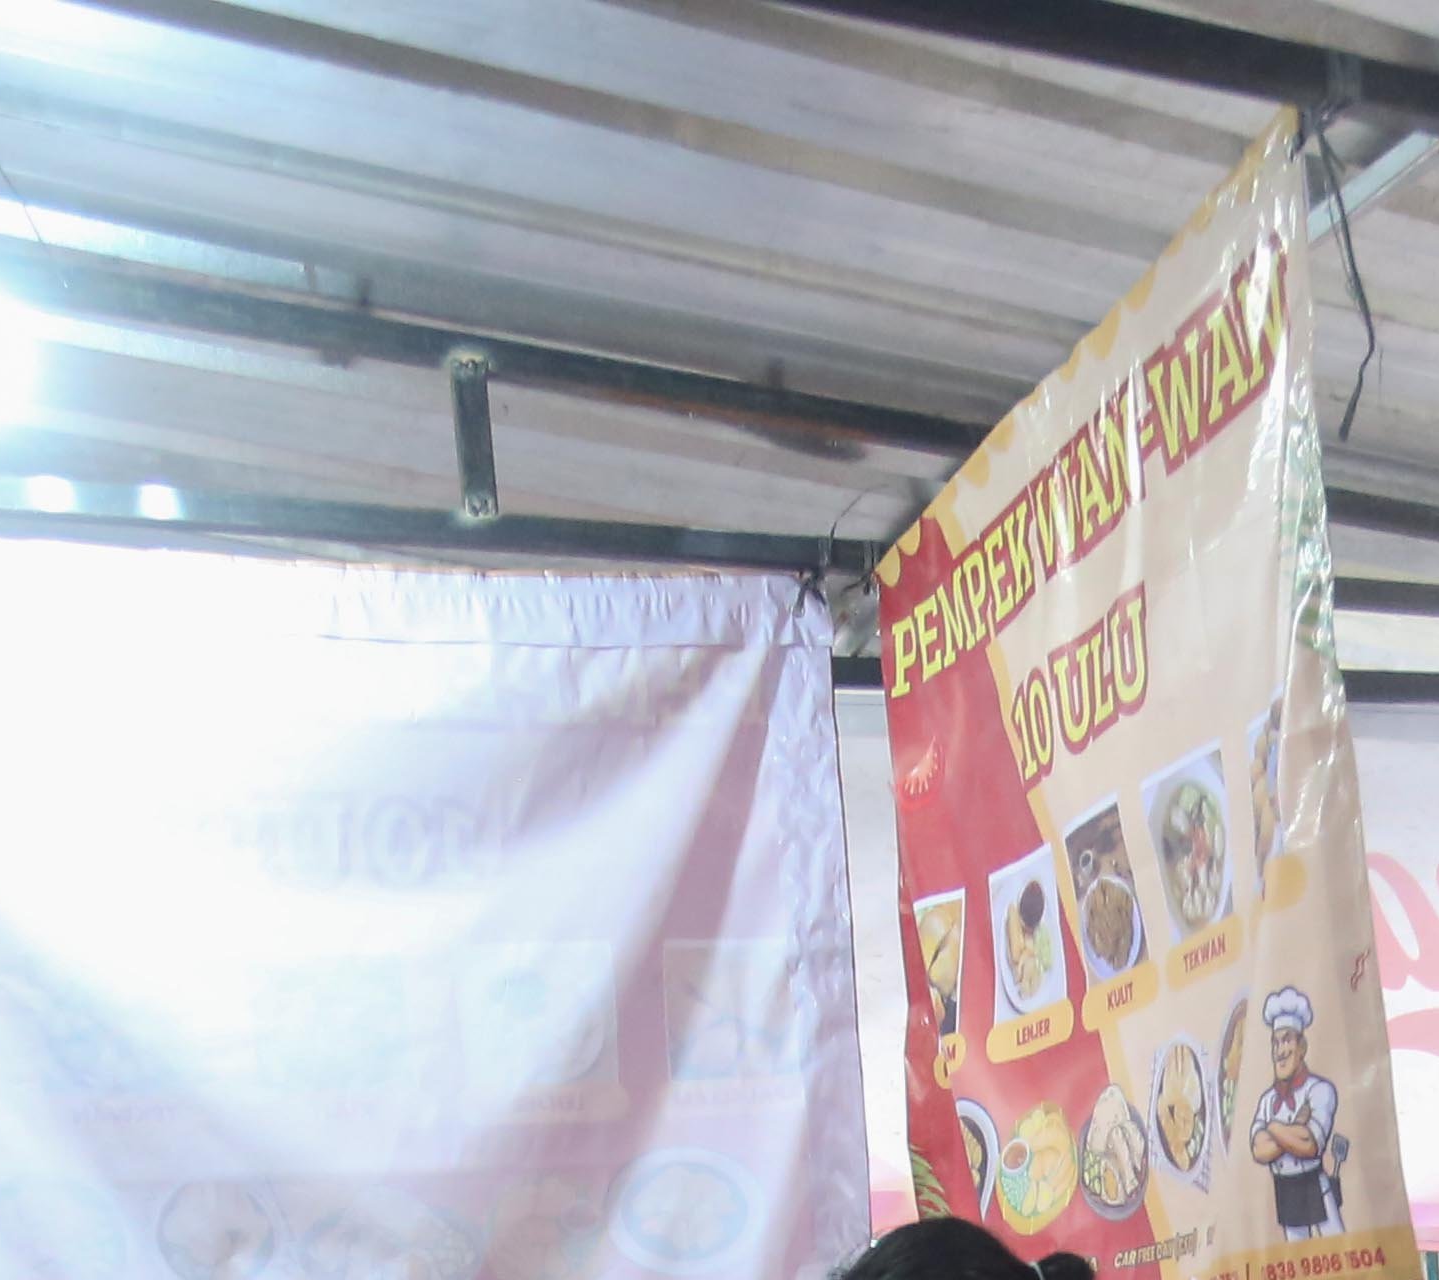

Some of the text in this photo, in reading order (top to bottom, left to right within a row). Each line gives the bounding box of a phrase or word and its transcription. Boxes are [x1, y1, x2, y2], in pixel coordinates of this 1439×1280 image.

[891, 510, 1037, 700] PEMPEK
[1012, 594, 1148, 779] 10 ULU
[1183, 934, 1226, 974] TEKWAN
[1114, 1252, 1138, 1270] CAR
